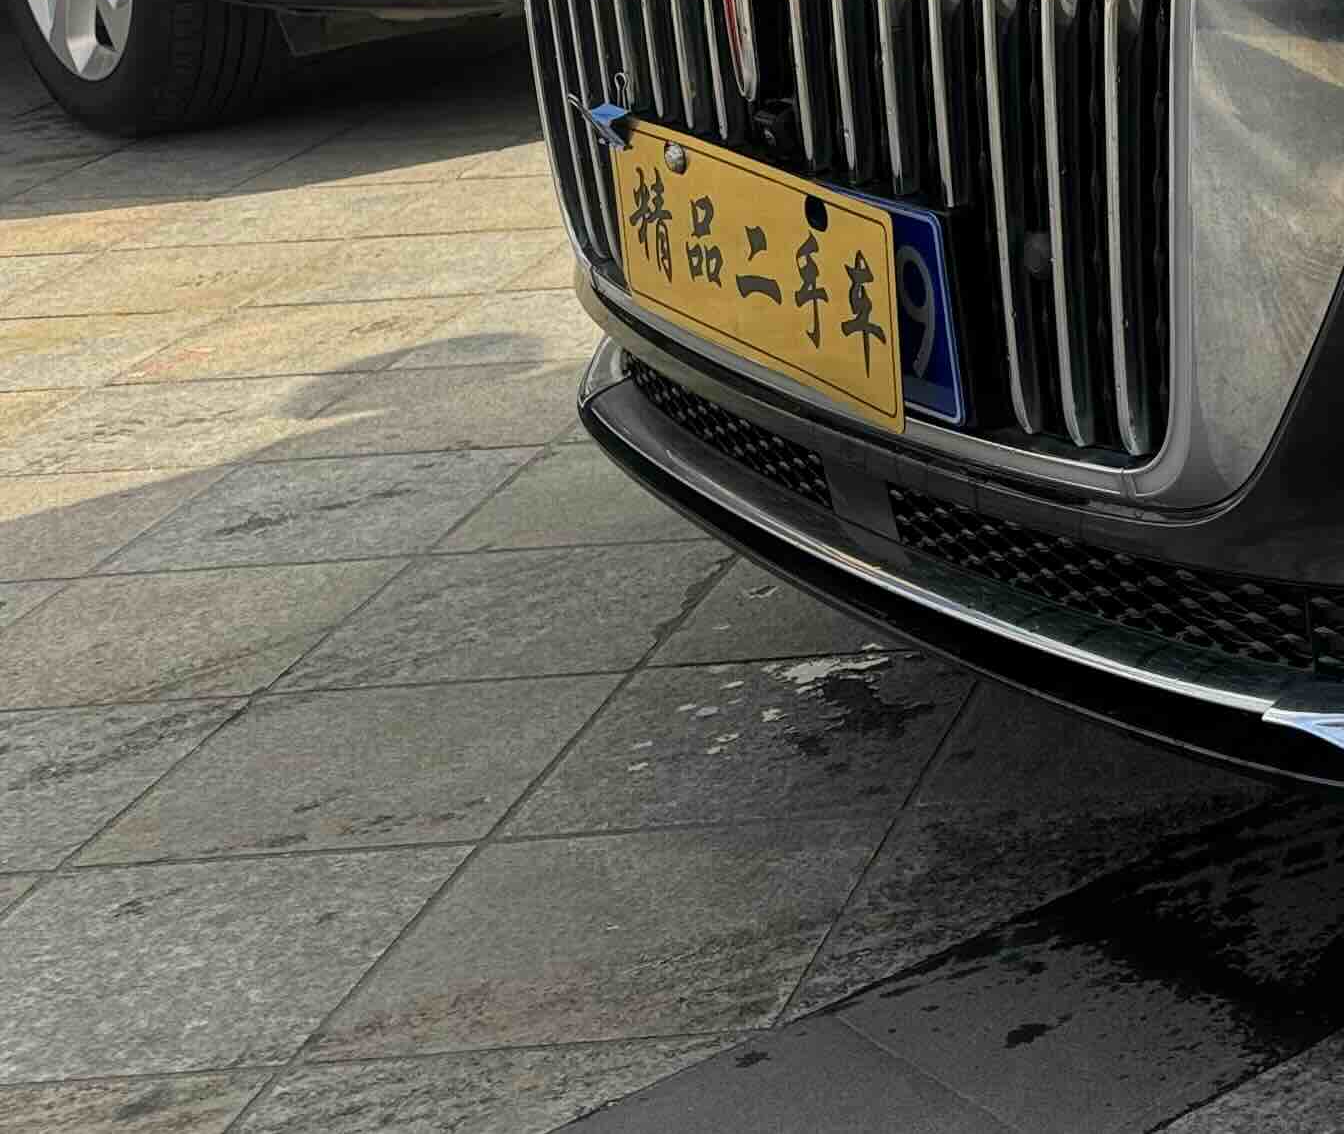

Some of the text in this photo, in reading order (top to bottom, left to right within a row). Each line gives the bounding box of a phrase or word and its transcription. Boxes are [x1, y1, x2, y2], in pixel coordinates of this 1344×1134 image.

[629, 166, 887, 379] 精品二手车
